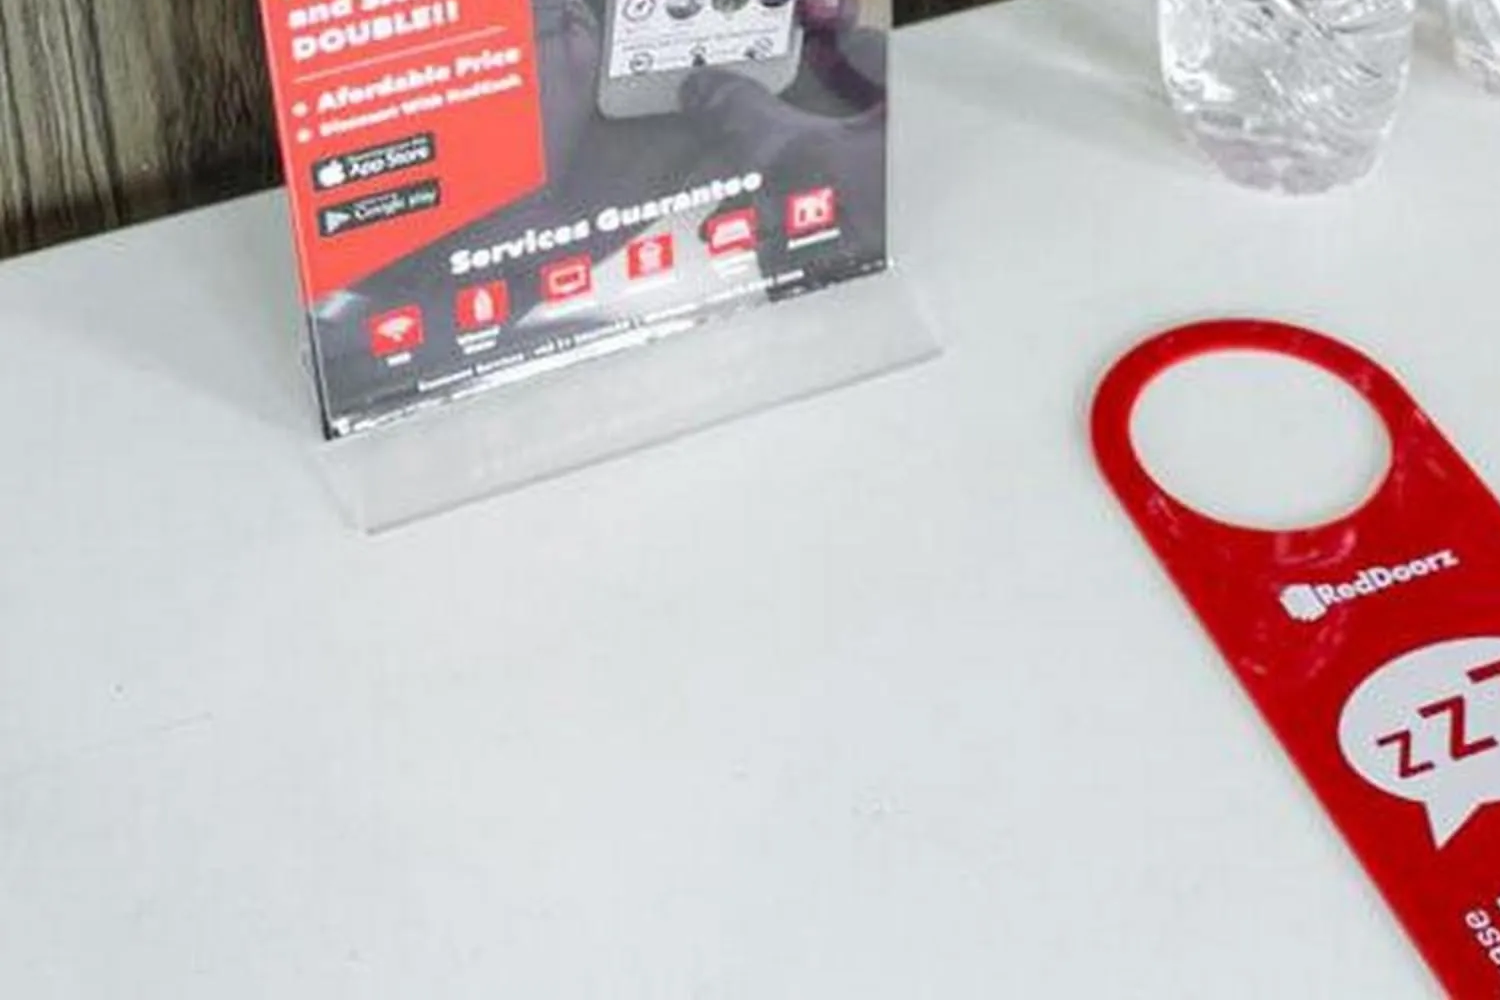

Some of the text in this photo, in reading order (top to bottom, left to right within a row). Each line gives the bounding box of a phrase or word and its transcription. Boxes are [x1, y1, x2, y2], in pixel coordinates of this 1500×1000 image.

[292, 0, 457, 60] DOUBLE!!
[455, 47, 521, 76] Price
[450, 173, 761, 273] Services Guarantee
[1316, 550, 1457, 605] RedDoorz
